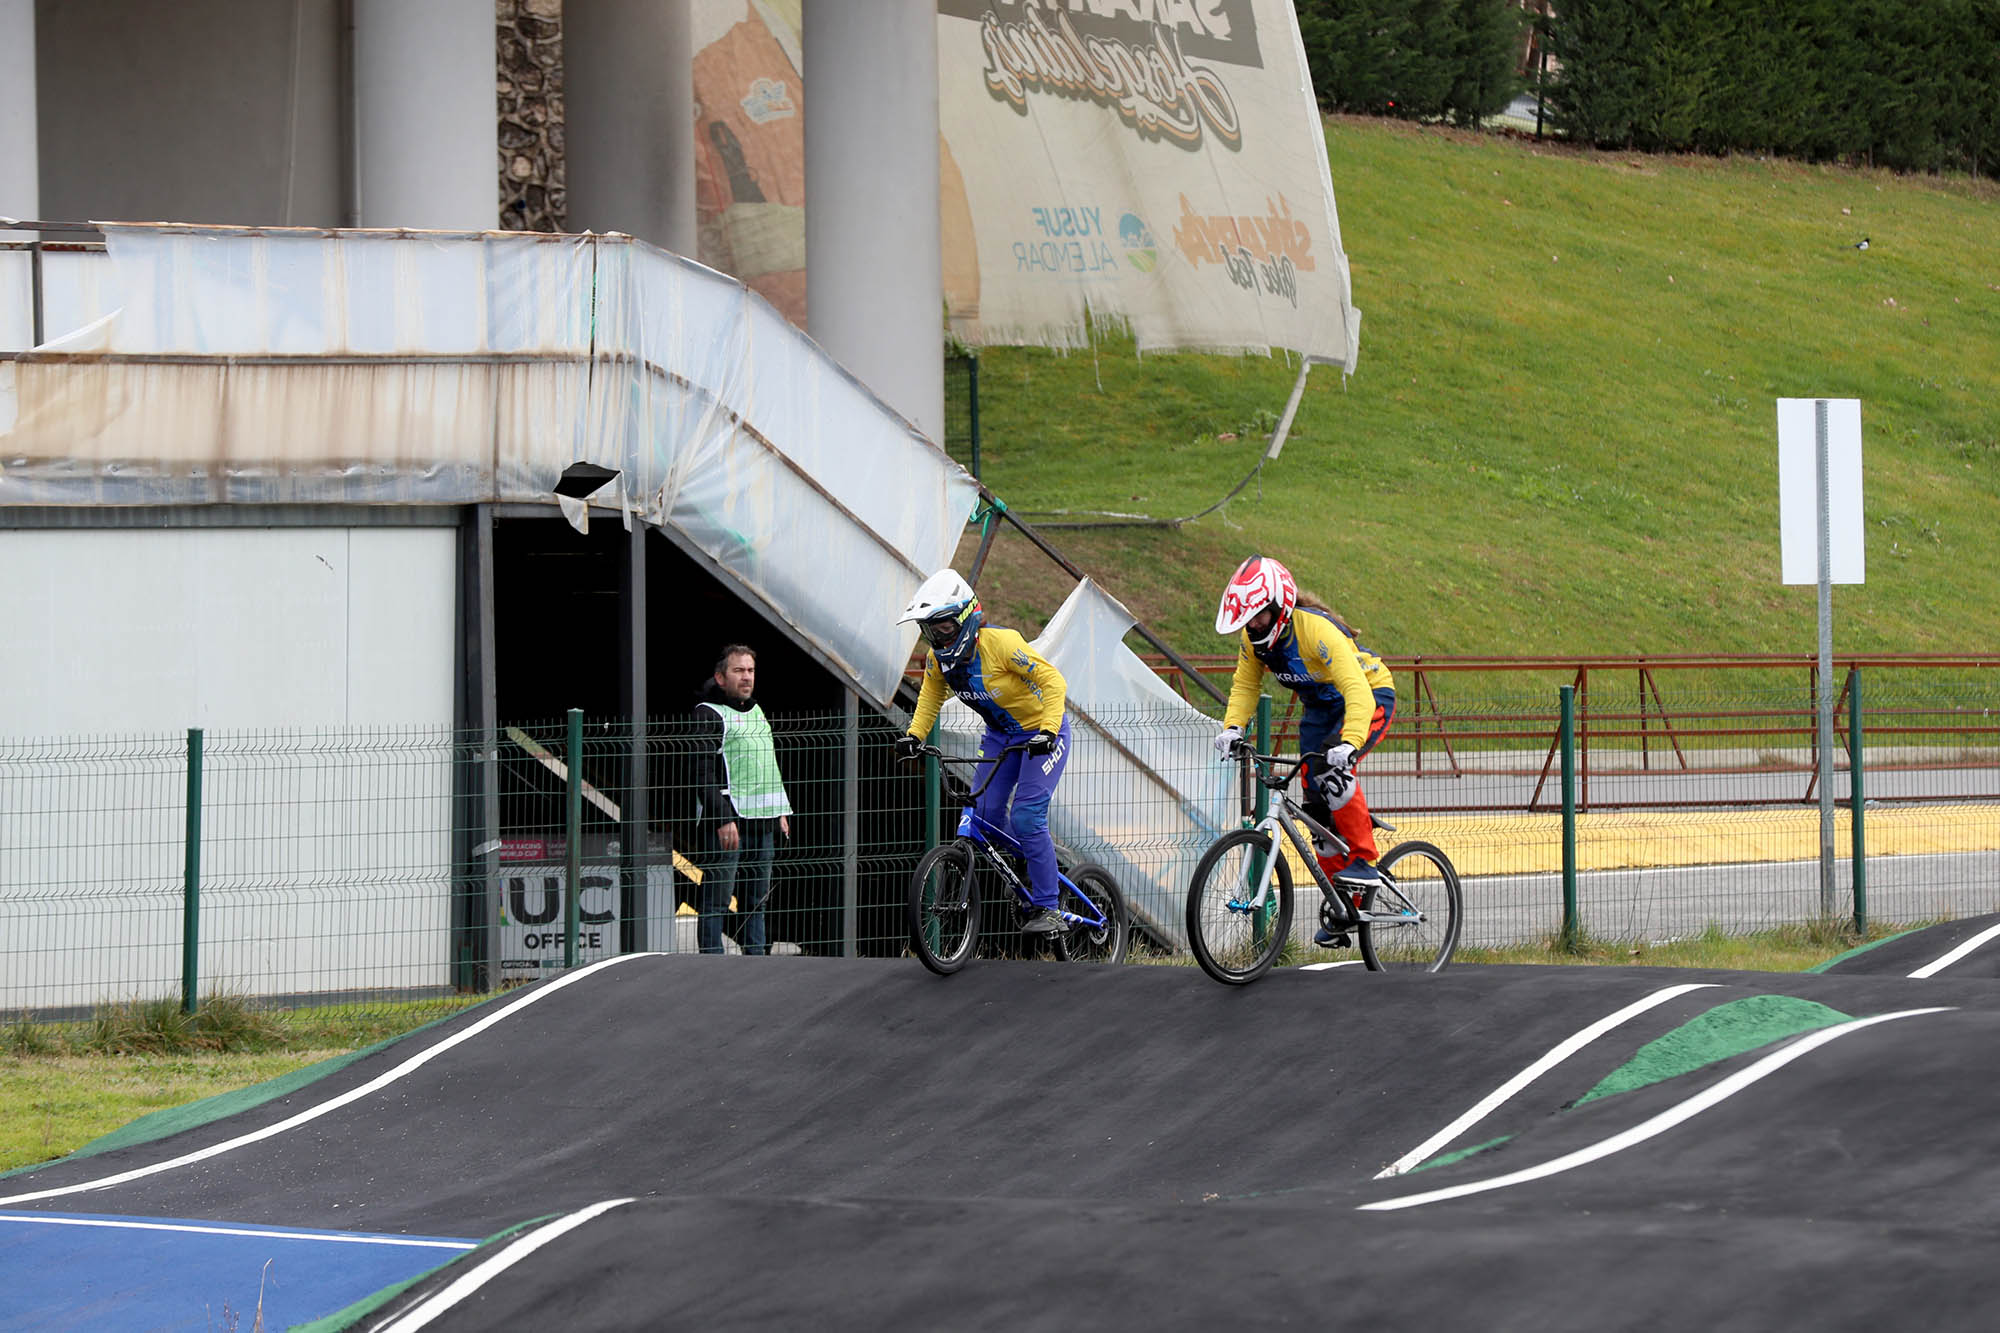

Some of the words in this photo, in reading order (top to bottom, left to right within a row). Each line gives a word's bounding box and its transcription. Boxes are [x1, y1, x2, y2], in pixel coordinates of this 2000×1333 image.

[1274, 670, 1322, 683] KRAINE
[955, 686, 1003, 701] KRAINE
[1019, 674, 1044, 703] UKRA
[1041, 737, 1066, 776] SHOT
[509, 876, 616, 925] UC
[524, 932, 601, 950] OFFCE
